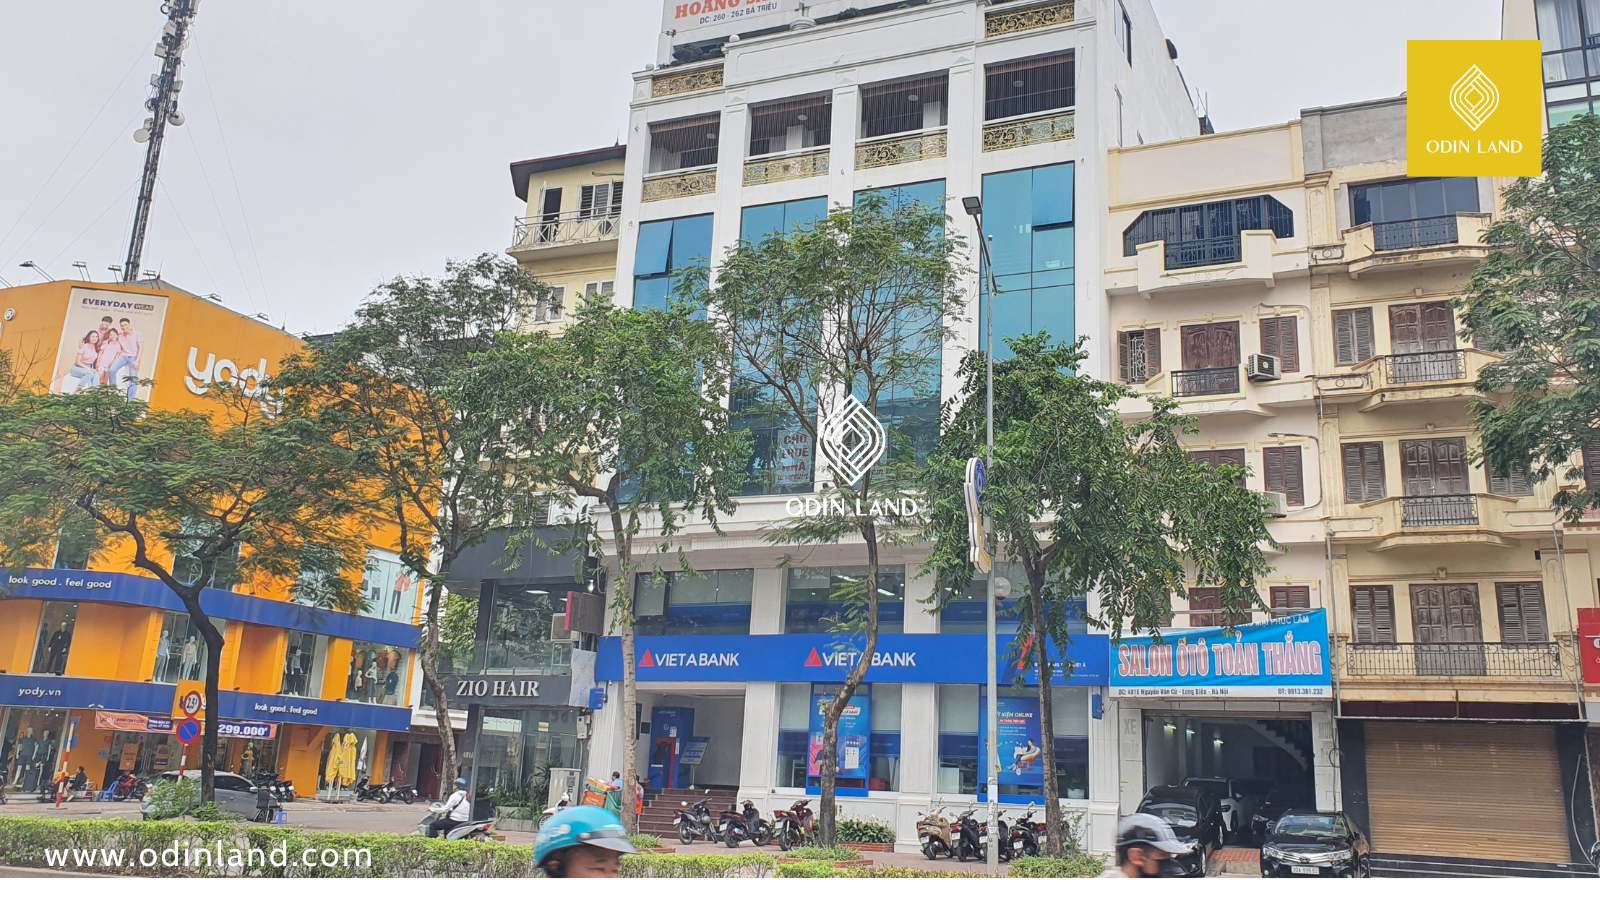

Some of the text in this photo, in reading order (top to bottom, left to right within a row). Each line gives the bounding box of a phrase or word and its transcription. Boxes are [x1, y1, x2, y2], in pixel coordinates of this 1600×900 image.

[82, 298, 133, 309] EVERYDAY
[8, 575, 28, 584] look
[32, 578, 57, 587] good
[65, 577, 84, 587] feel
[86, 580, 112, 590] good
[655, 652, 740, 667] VIETABANK
[1118, 643, 1172, 677] SALON
[18, 687, 61, 698] yody.vn
[456, 680, 540, 697] ZIO HAIR
[254, 702, 268, 711] look
[270, 704, 286, 713] good
[290, 705, 301, 714] feel
[302, 707, 317, 716] good
